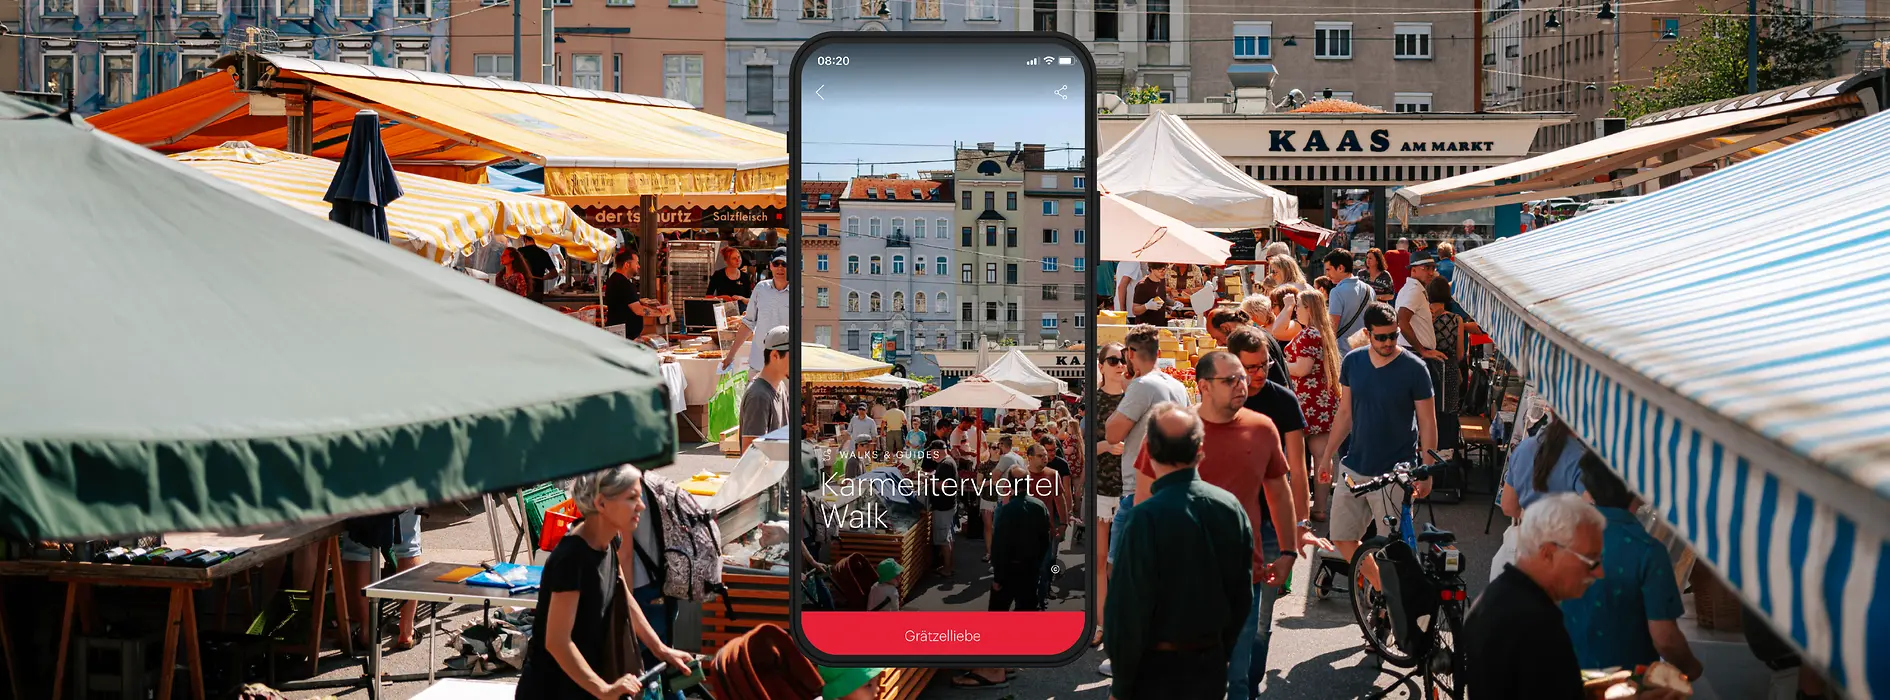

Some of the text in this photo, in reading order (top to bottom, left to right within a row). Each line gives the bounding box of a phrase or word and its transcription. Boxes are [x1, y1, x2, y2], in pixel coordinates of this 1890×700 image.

[817, 56, 850, 66] 08:20
[1268, 129, 1494, 152] KAAS AM MARKT
[595, 210, 623, 223] der
[713, 211, 768, 222] Salzfleisch
[1056, 355, 1086, 366] KA
[839, 451, 940, 459] WALKS & GUIDES
[822, 470, 1059, 497] Karmeliterviertel
[821, 502, 888, 529] Walk
[904, 629, 981, 642] Grätzelliebe
